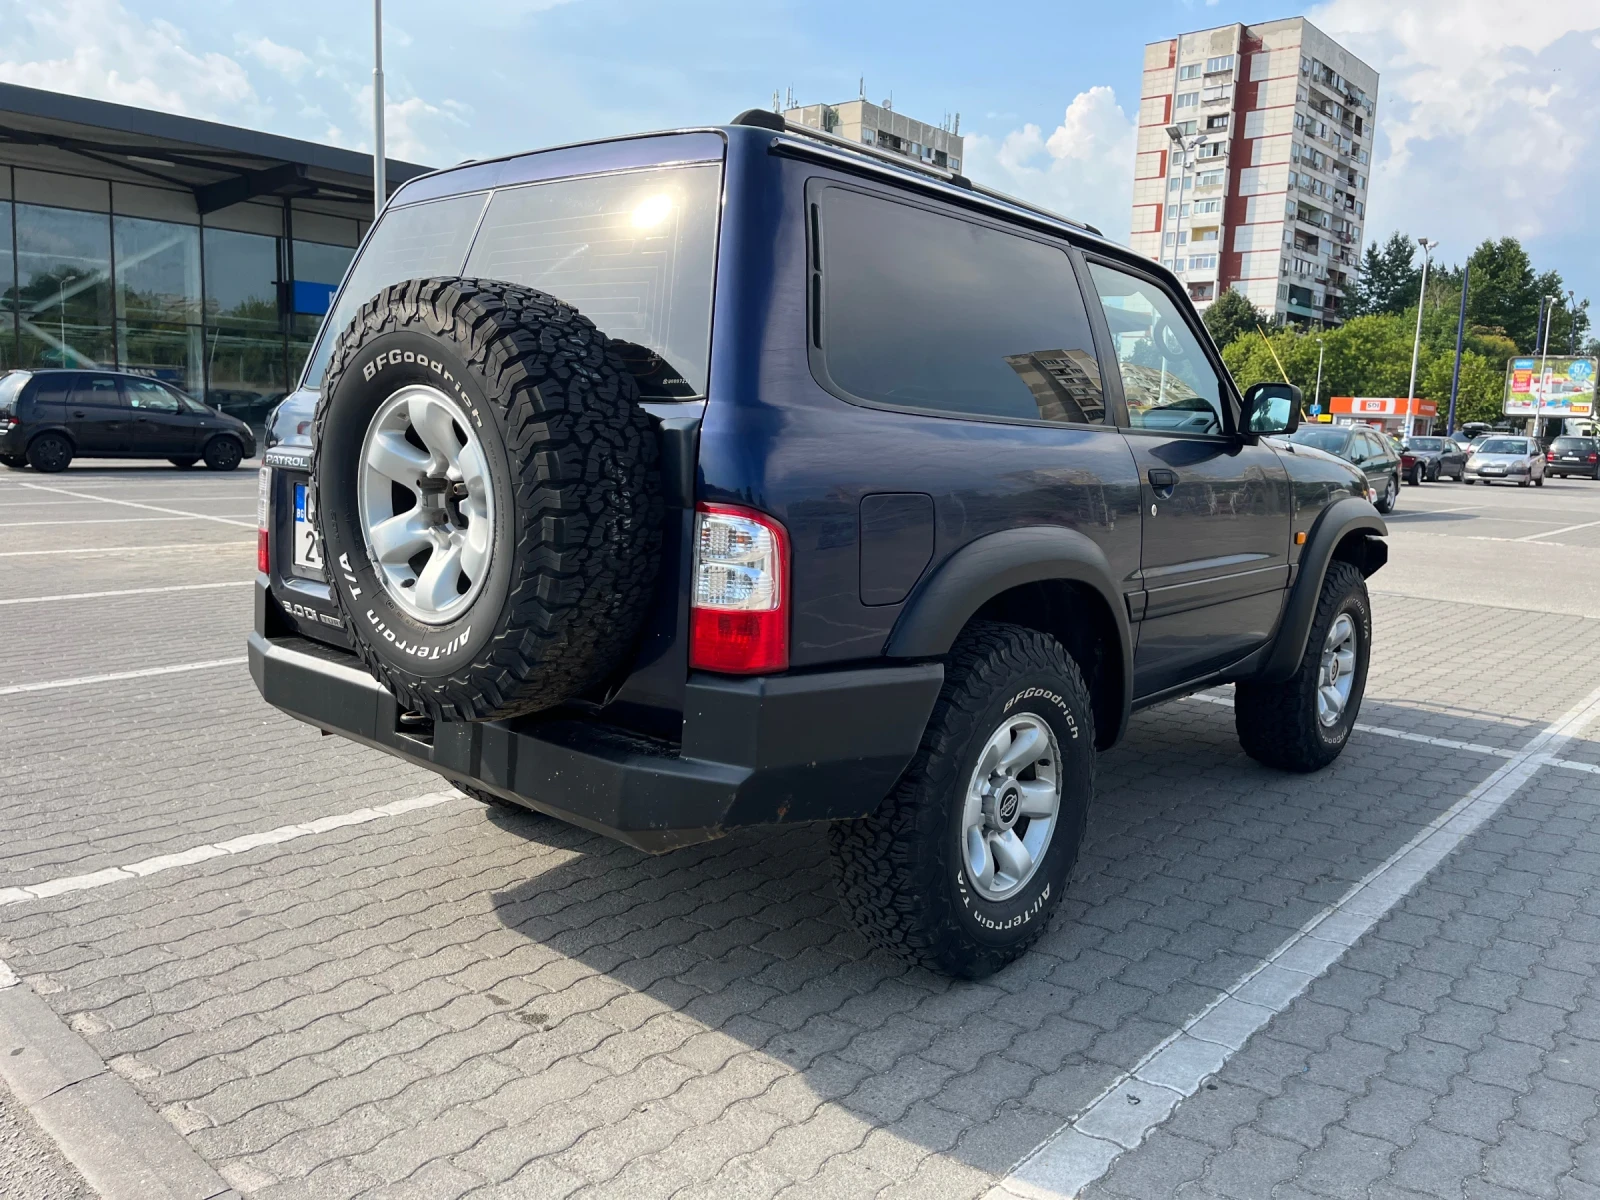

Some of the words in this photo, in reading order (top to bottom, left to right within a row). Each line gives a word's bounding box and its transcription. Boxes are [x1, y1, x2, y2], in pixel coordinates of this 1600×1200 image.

[363, 349, 483, 428] BFGoodrich
[265, 454, 308, 467] PATROL
[296, 508, 305, 519] BG
[339, 552, 363, 601] T/A
[366, 609, 472, 660] All-Terrain
[1003, 687, 1079, 739] BFGoodrich
[957, 870, 969, 909] T/A
[974, 882, 1050, 930] All-Terrain
